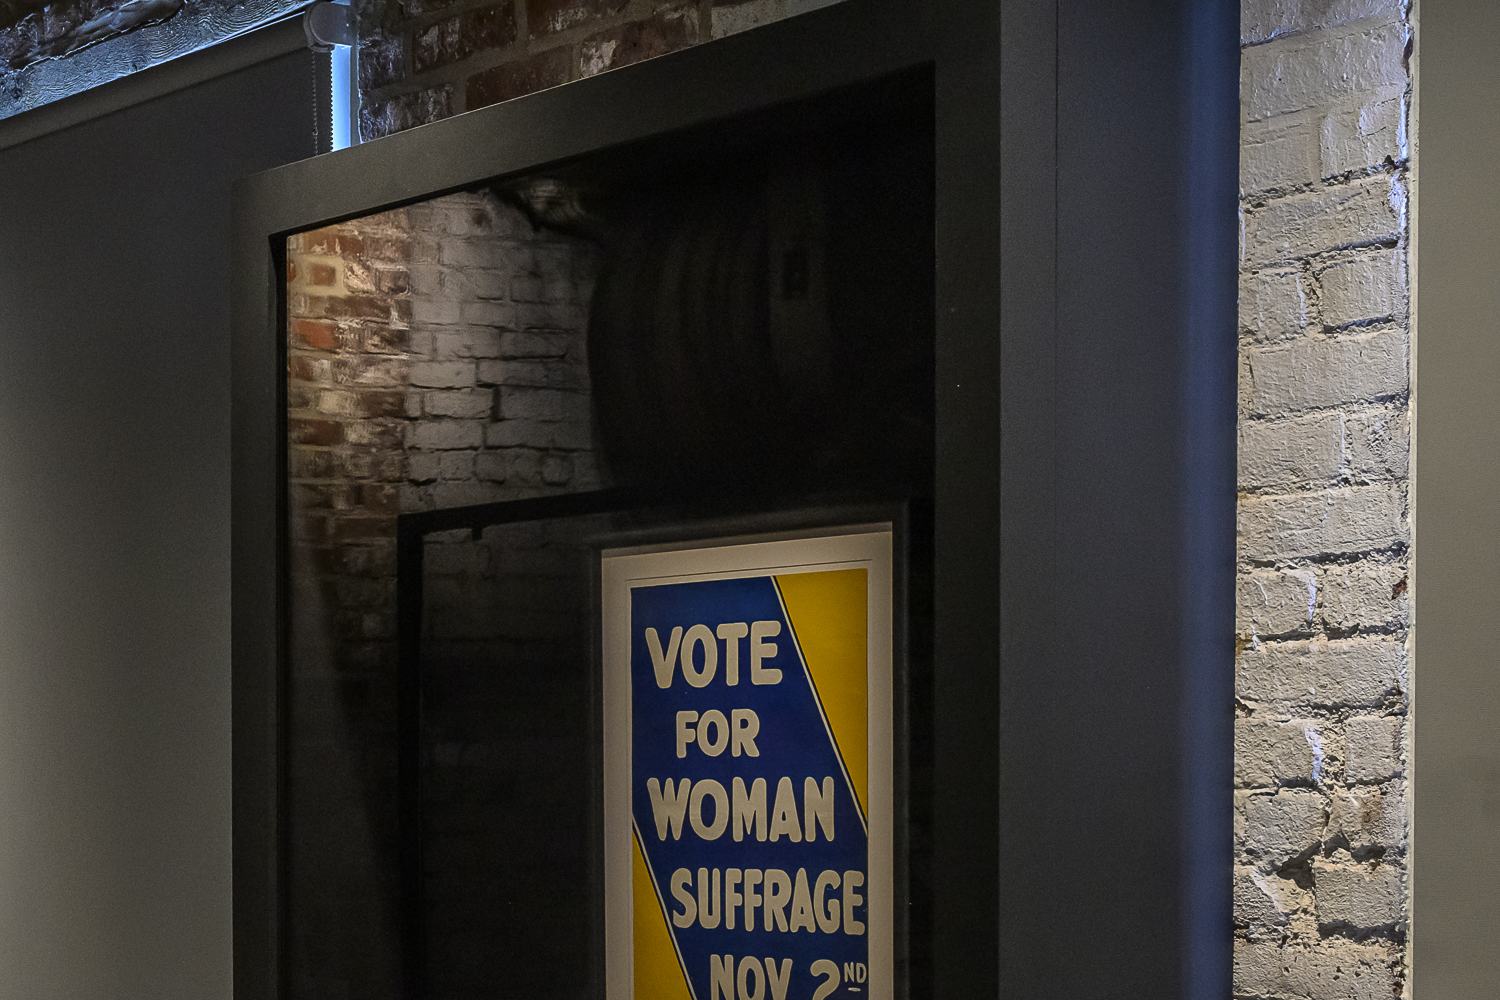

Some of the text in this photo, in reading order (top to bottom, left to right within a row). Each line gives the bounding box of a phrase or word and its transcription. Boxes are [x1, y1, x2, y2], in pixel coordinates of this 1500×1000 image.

[645, 620, 783, 689] VOTE
[676, 708, 760, 758] FOR
[647, 776, 834, 842] WOMAN
[670, 867, 866, 935] SUFFRAGE
